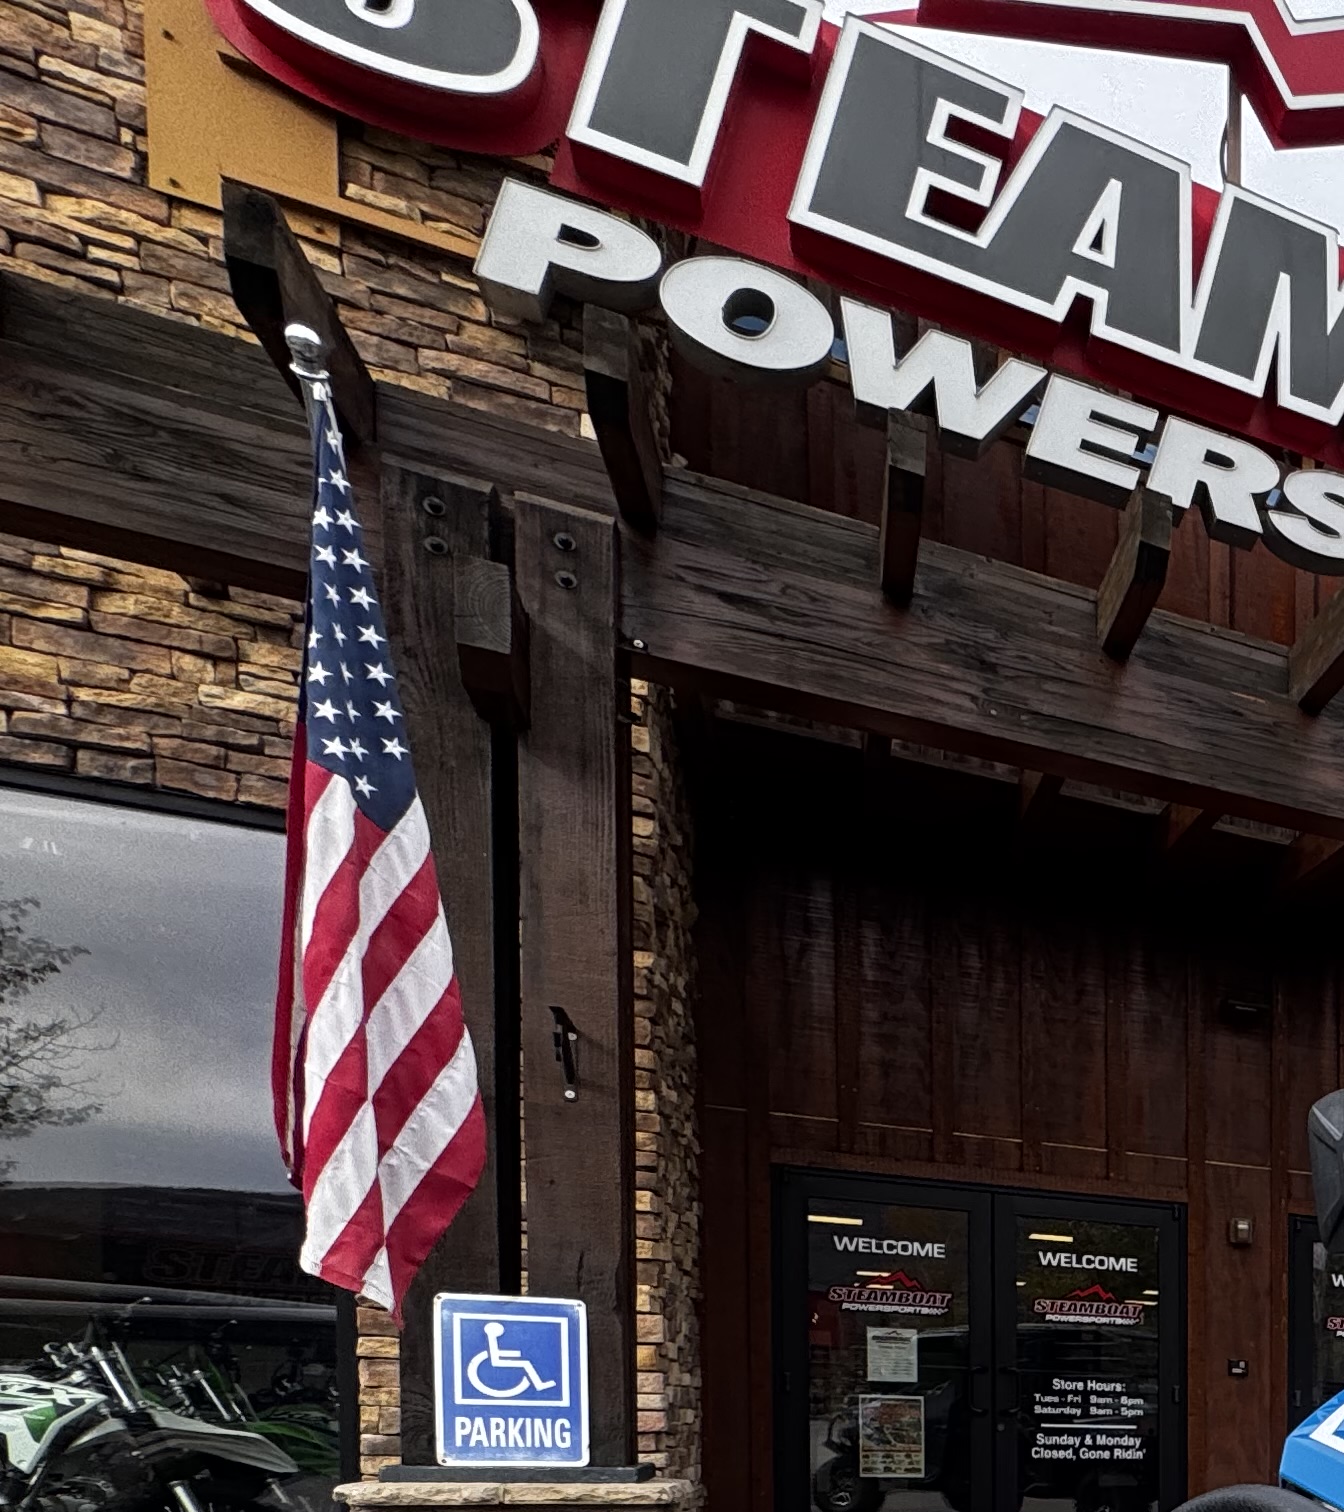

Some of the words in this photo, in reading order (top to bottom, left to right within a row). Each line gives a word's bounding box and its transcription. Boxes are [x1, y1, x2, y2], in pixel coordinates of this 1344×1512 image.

[833, 1235, 946, 1258] WELCOME
[1038, 1251, 1138, 1272] WELCOME
[829, 1286, 952, 1307] STEAMBOAT
[841, 1302, 929, 1315] POWERSPORTS
[1034, 1299, 1143, 1318] STEAMBOAT
[1045, 1313, 1124, 1325] POWERSPORTS
[1052, 1378, 1084, 1391] Store
[1086, 1379, 1127, 1392] Hours:
[1034, 1393, 1060, 1403] Tues
[1067, 1394, 1082, 1403] Fri
[1034, 1405, 1082, 1416] Saturday
[455, 1416, 572, 1450] PARKING
[1036, 1433, 1081, 1448] Sunday
[1084, 1434, 1093, 1445] &
[1096, 1434, 1142, 1449] Monday
[1031, 1447, 1076, 1460] Closed,
[1079, 1448, 1110, 1459] Gone
